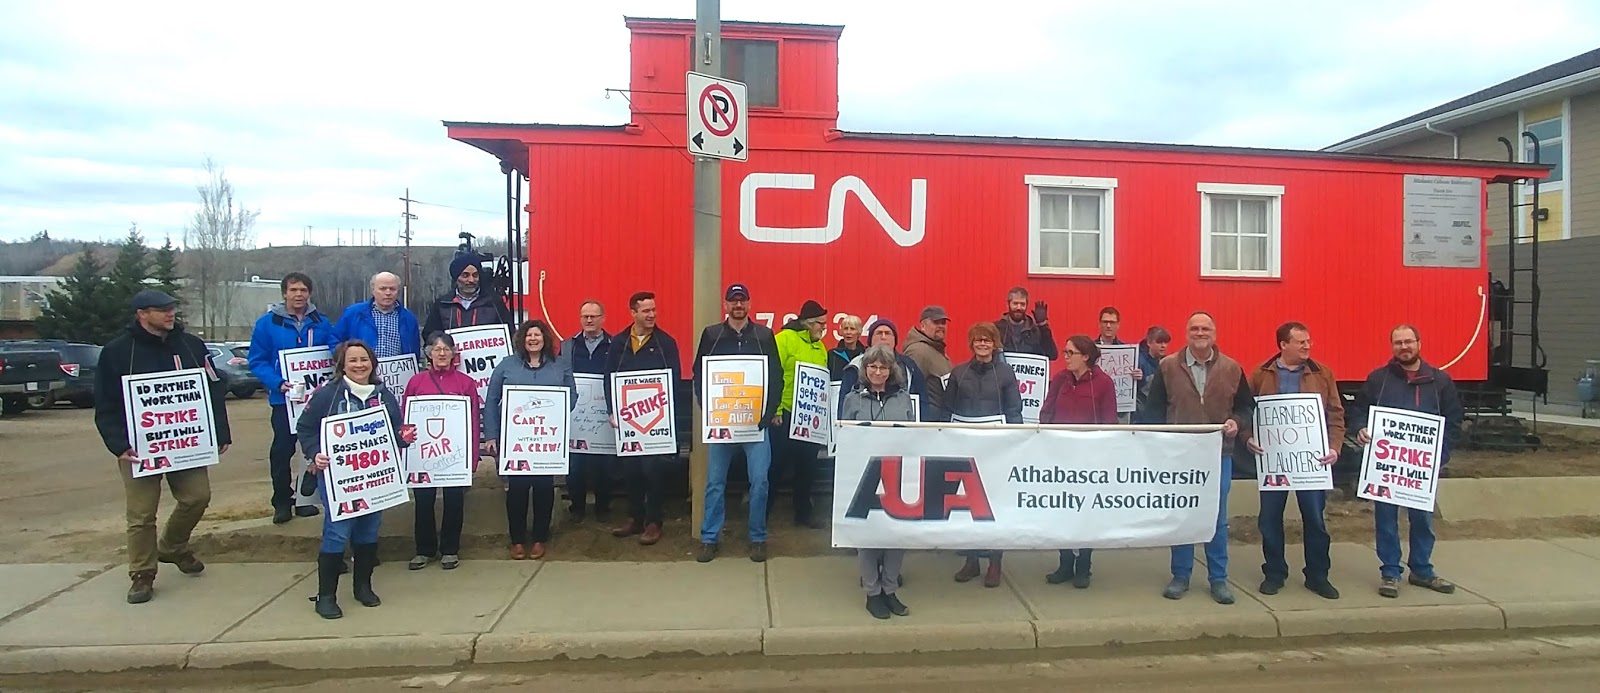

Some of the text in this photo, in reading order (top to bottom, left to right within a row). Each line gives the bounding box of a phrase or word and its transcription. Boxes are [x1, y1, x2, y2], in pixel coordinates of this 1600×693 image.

[739, 172, 927, 247] CN
[456, 337, 506, 352] LEARNERS
[290, 358, 335, 372] LEARNER
[464, 355, 497, 374] NOT
[1101, 352, 1130, 366] FAIR
[376, 363, 388, 377] OU
[1011, 363, 1045, 377] EARNERS
[154, 379, 197, 394] RATHER
[800, 371, 826, 390] Prez
[140, 391, 202, 407] WORK THAN
[799, 387, 818, 403] gets
[411, 402, 460, 416] Imagine
[620, 391, 668, 422] STRIKE
[797, 412, 812, 426] get
[1258, 404, 1316, 426] LEARNERS
[145, 426, 204, 442] BUT I WILL
[348, 419, 386, 435] Imagine
[533, 426, 558, 436] FLY
[624, 428, 669, 438] NO CUTS
[707, 428, 732, 439] AUFA
[793, 426, 810, 438] AUFA
[1382, 418, 1437, 436] I'D RATHER
[332, 434, 388, 454] BOSS MAKES
[1267, 426, 1314, 446] NOT
[1383, 429, 1434, 445] WORK THAN
[420, 438, 452, 459] FAIR
[512, 443, 561, 452] A CREW!
[569, 440, 588, 450] UFA
[621, 441, 643, 452] AUFA
[1266, 450, 1324, 473] LAWYERS
[1374, 439, 1432, 469] STRIKE
[138, 456, 172, 472] AUFA
[504, 460, 531, 471] AUFA
[1375, 462, 1430, 480] BUT I WILL
[337, 467, 396, 485] OFFERS WORKERS
[406, 472, 432, 484] AUFA
[1007, 465, 1210, 487] Athabasca University
[1263, 474, 1291, 486] AUFA
[1381, 473, 1423, 490] STRIKE
[845, 455, 996, 522] AUFA
[1363, 483, 1392, 499] AUFA
[336, 498, 370, 517] AUFA
[1017, 491, 1200, 512] Faculty Association
